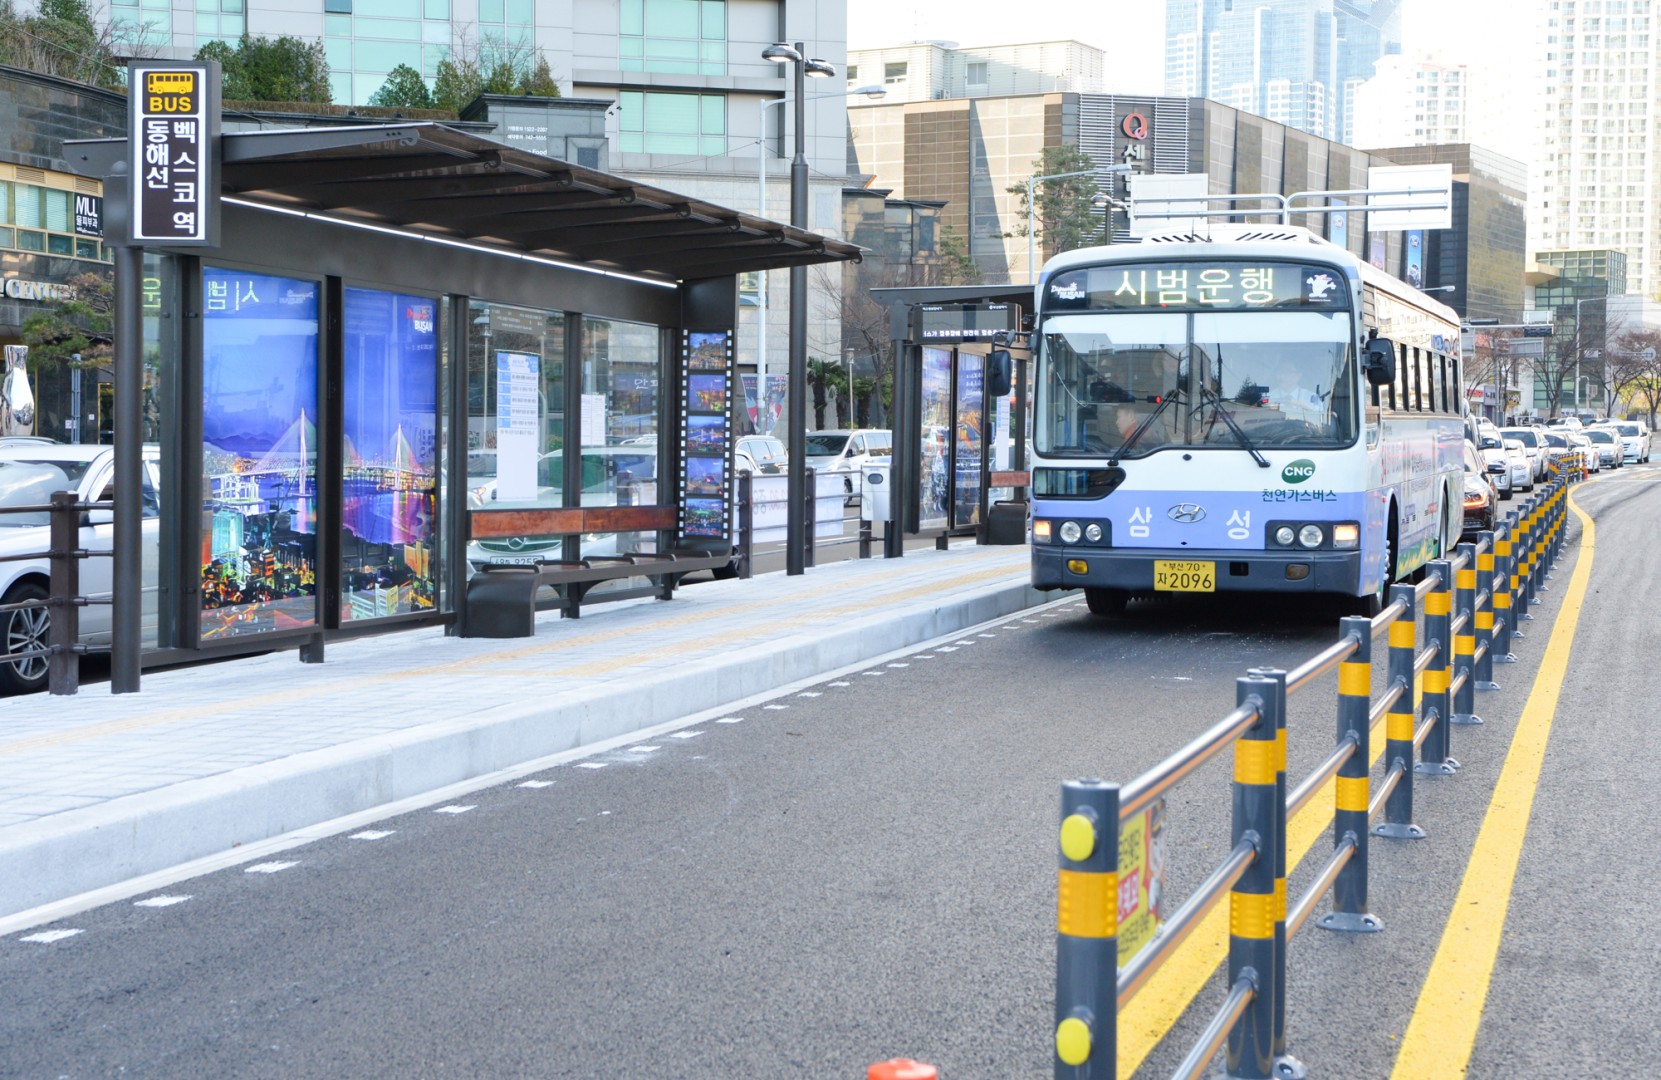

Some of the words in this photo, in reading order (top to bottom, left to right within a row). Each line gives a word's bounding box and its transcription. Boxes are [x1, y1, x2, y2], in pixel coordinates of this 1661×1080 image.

[149, 96, 192, 112] BUS
[145, 120, 170, 189] 동해선
[1114, 268, 1273, 305] 시범운행
[1284, 466, 1313, 477] CNG
[1262, 488, 1338, 503] 천연가스버스
[1128, 506, 1153, 538] 삼
[1225, 509, 1251, 540] 성
[1169, 562, 1184, 571] 부산
[1186, 563, 1200, 571] 70
[1157, 572, 1168, 585] 자
[1169, 572, 1212, 589] 2096
